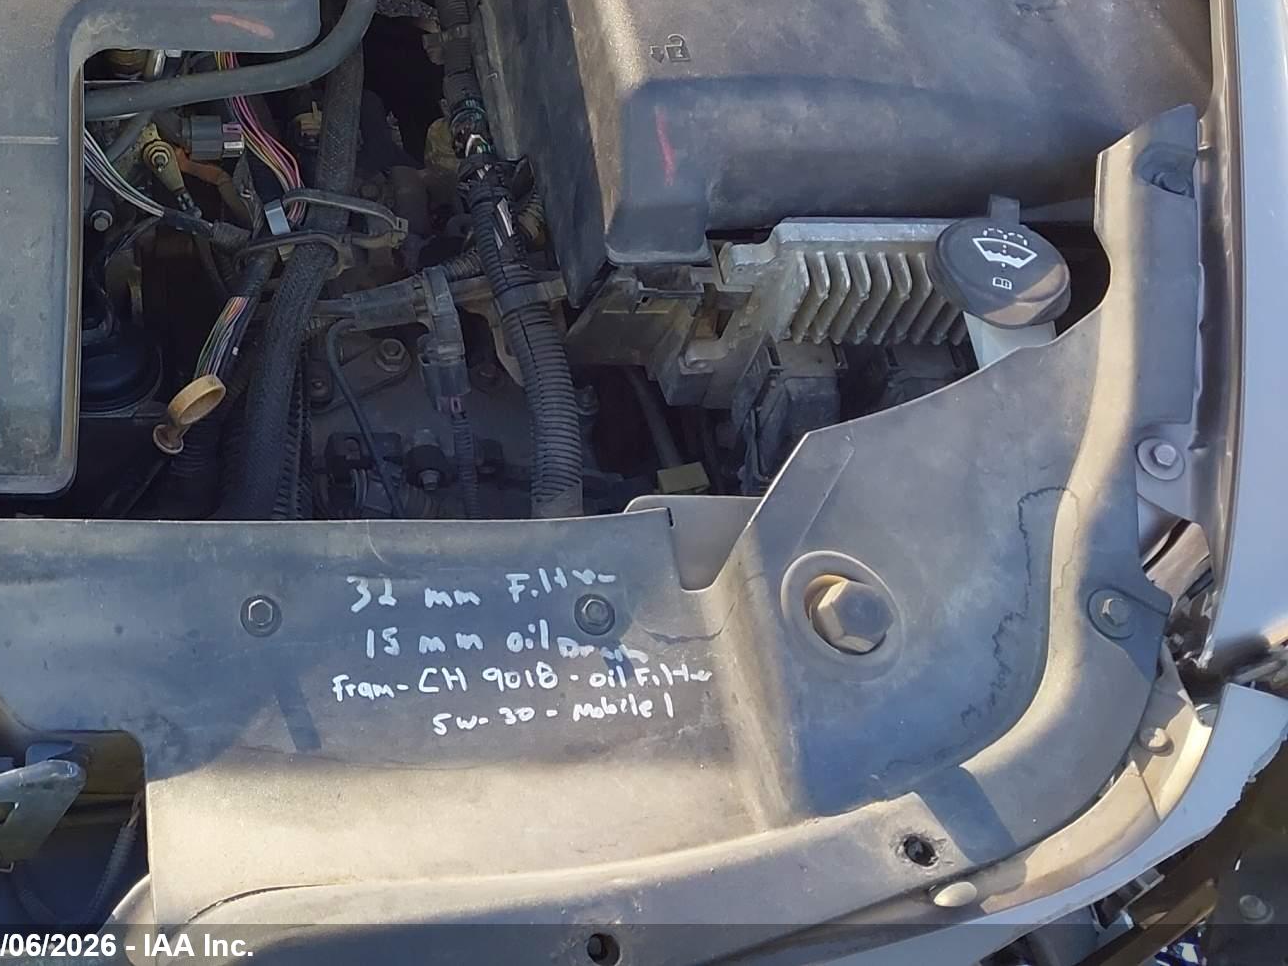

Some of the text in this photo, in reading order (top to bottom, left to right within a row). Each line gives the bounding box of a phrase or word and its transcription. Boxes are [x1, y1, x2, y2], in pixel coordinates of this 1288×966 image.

[346, 575, 398, 613] 32
[424, 586, 481, 609] mm
[366, 627, 400, 658] 15
[507, 619, 550, 653] oil
